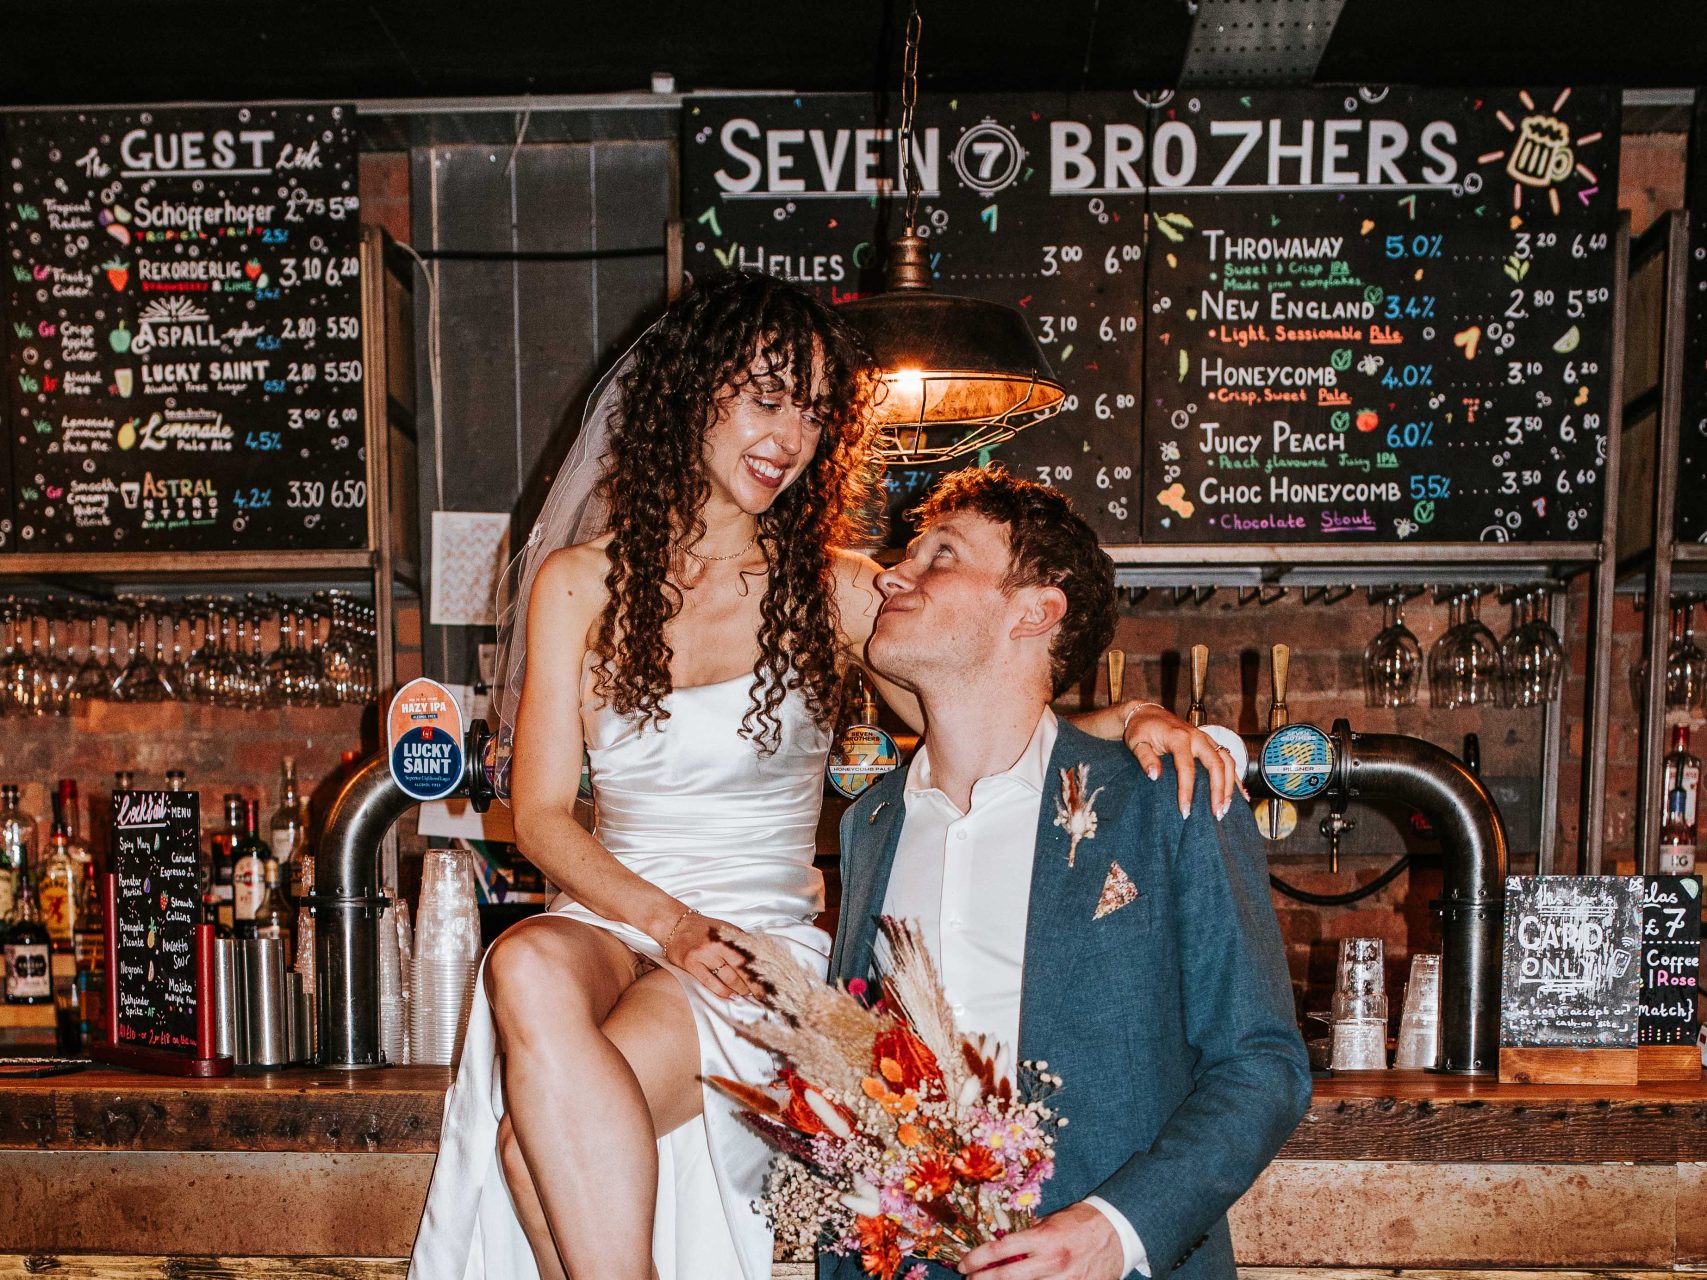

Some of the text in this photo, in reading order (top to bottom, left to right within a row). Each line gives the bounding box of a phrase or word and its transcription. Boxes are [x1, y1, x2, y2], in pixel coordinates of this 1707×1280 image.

[120, 128, 275, 170] GUEST
[714, 118, 1458, 192] SEVEN 7 BRO7HERS
[1202, 229, 1344, 262] THROWAWAY
[1385, 234, 1443, 259] 5.0%
[139, 259, 242, 280] REKORDERLIG
[739, 246, 845, 282] HELLES
[1223, 262, 1269, 277] Sweet
[1223, 278, 1260, 291] Made
[1201, 290, 1260, 320] NEW
[1270, 292, 1375, 320] ENGLAND
[131, 322, 221, 354] ASPALL
[1275, 324, 1363, 341] Sessionable
[141, 362, 201, 383] LUCKY
[208, 359, 270, 382] SAINT
[1201, 357, 1338, 387] HONEYCOMB
[1264, 389, 1307, 402] Sweet
[1199, 422, 1262, 454] JUICY
[1273, 420, 1345, 453] PEACH
[1376, 452, 1399, 467] IPA
[142, 471, 217, 497] ASTRAL
[1199, 477, 1262, 505] CHOC
[1270, 476, 1401, 504] HONEYCOMB
[1220, 513, 1306, 530] Chocolate
[401, 702, 446, 713] HAZY IPA
[403, 743, 452, 758] LUCKY
[403, 758, 452, 774] SAINT
[117, 792, 192, 826] Cocktail MENU
[160, 866, 186, 881] Espresso
[166, 910, 191, 924] Collins
[122, 933, 145, 948] Picante
[1518, 915, 1603, 951] CARD
[120, 960, 144, 980] Negroni
[1521, 957, 1595, 978] ONLY
[1646, 949, 1700, 974] Coffee
[168, 978, 193, 994] Mojito
[1657, 970, 1696, 987] Rose
[1570, 1006, 1609, 1019] accept
